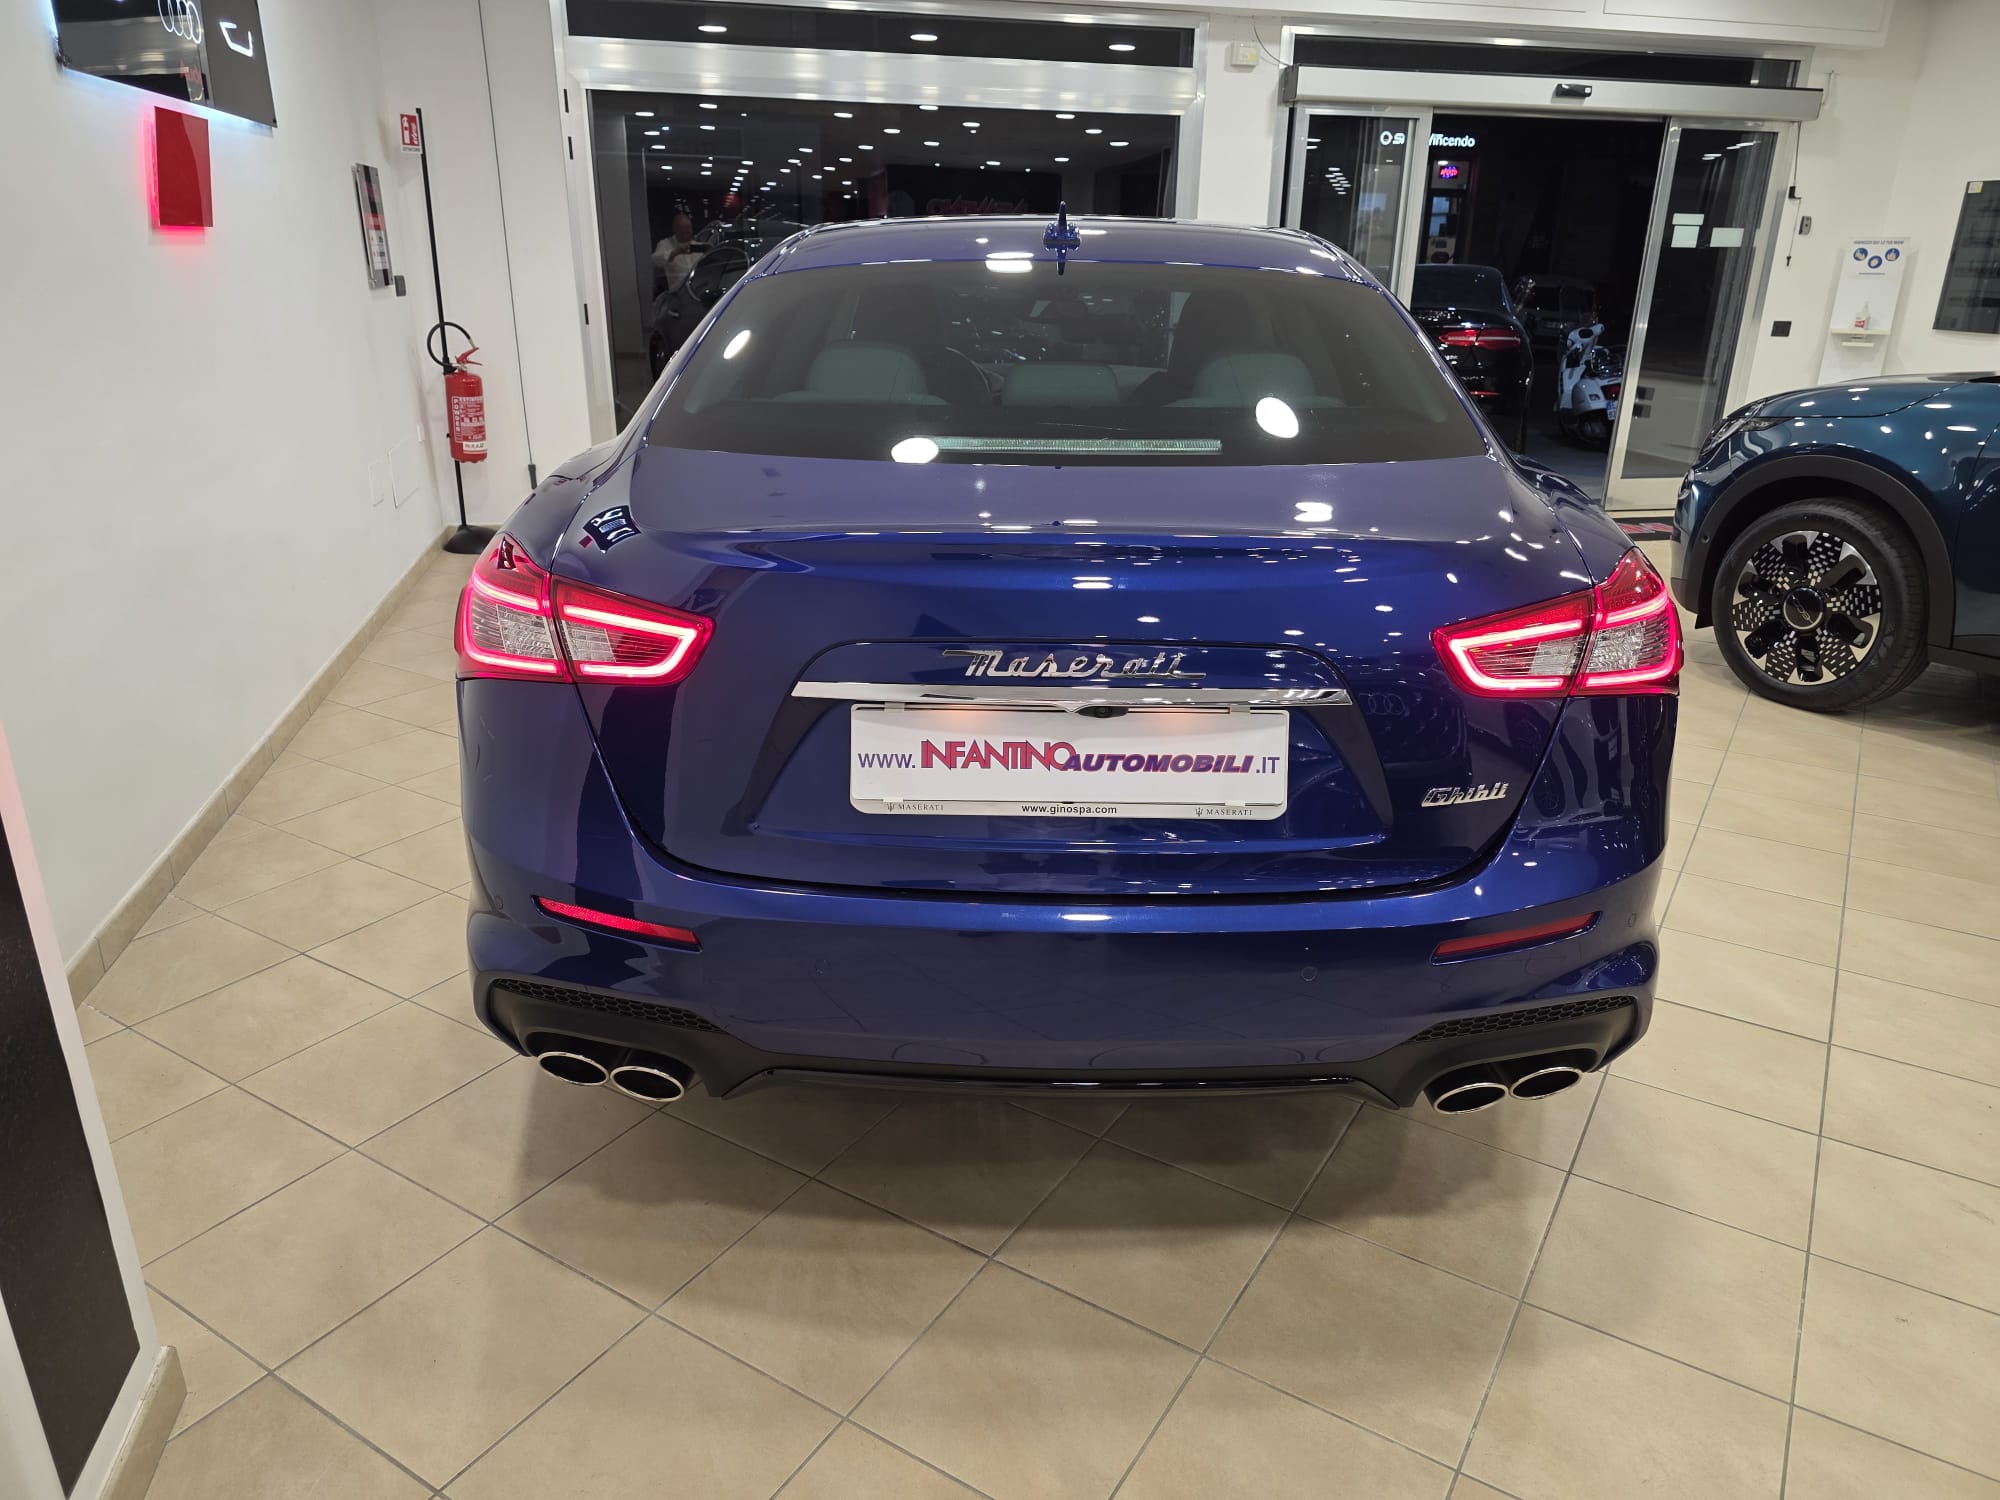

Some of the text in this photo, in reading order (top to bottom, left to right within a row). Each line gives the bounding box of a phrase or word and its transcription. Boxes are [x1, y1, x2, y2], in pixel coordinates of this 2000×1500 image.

[942, 649, 1206, 678] Maserati
[1421, 782, 1509, 807] Ghibli
[898, 803, 944, 811] MASERATI
[1021, 804, 1117, 816] www.ginospa.com
[1206, 808, 1253, 816] MASERATI
